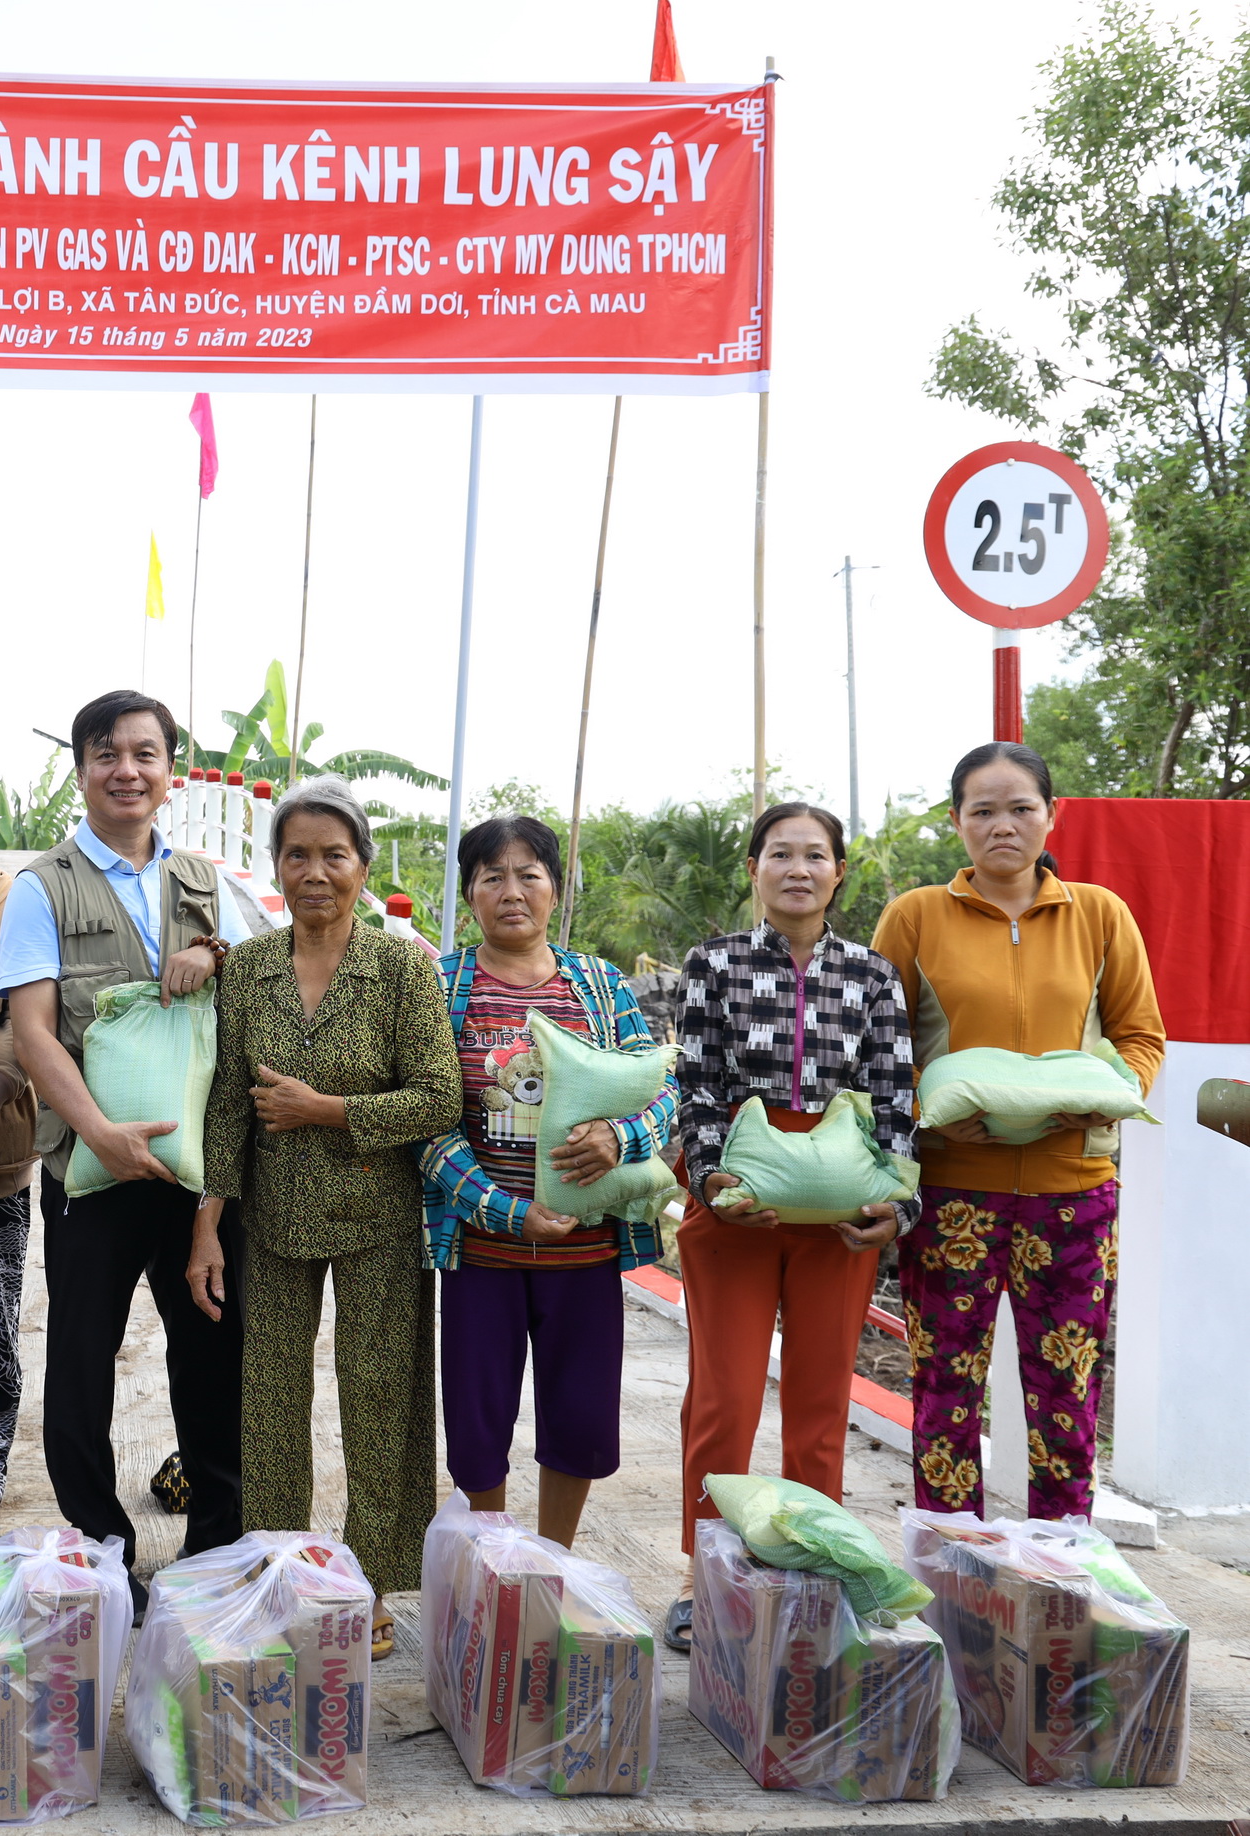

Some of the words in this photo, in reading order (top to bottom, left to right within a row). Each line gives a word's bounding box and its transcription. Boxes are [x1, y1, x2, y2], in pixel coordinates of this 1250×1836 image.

[123, 115, 239, 200] CẦU
[262, 128, 421, 204] KÊNH
[443, 145, 590, 207] LUNG
[608, 131, 719, 217] SẬY
[15, 227, 49, 270] PV
[57, 227, 107, 271] GAS
[115, 218, 149, 272] VÀ
[158, 229, 194, 273] CĐ
[203, 231, 257, 274] DAK
[282, 233, 340, 276] KCM
[365, 235, 431, 277] PTSC
[456, 235, 507, 275] CTY
[515, 233, 555, 275] MY
[560, 234, 631, 275] DUNG
[637, 232, 726, 275] TPHCM
[48, 290, 73, 315] B,
[80, 286, 116, 312] XÃ
[123, 286, 176, 314] TÂN
[184, 287, 247, 318] ĐỨC,
[255, 289, 345, 319] HUYỆN
[353, 284, 411, 314] ĐẦM
[420, 291, 469, 319] DƠI,
[477, 287, 536, 315] TỈNH
[545, 288, 581, 315] CÀ
[590, 292, 646, 314] MAU
[67, 325, 95, 346] 15
[102, 326, 166, 350] tháng
[174, 327, 190, 347] 5
[197, 327, 248, 347] năm
[255, 327, 313, 348] 2023
[79, 1611, 95, 1641] cay
[1046, 1594, 1060, 1630] Tôm
[319, 1613, 333, 1650] Tôm
[499, 1650, 511, 1674] Tôm
[496, 1676, 509, 1703] chua
[528, 1641, 550, 1723] KOKOMI
[568, 1680, 577, 1699] LONG
[577, 1654, 591, 1735] LOTHAMILK
[493, 1705, 504, 1725] cay
[869, 1661, 884, 1741] LOTHAMILK
[319, 1658, 349, 1782] KOKOMI
[631, 1750, 639, 1790] LOTHAMILK
